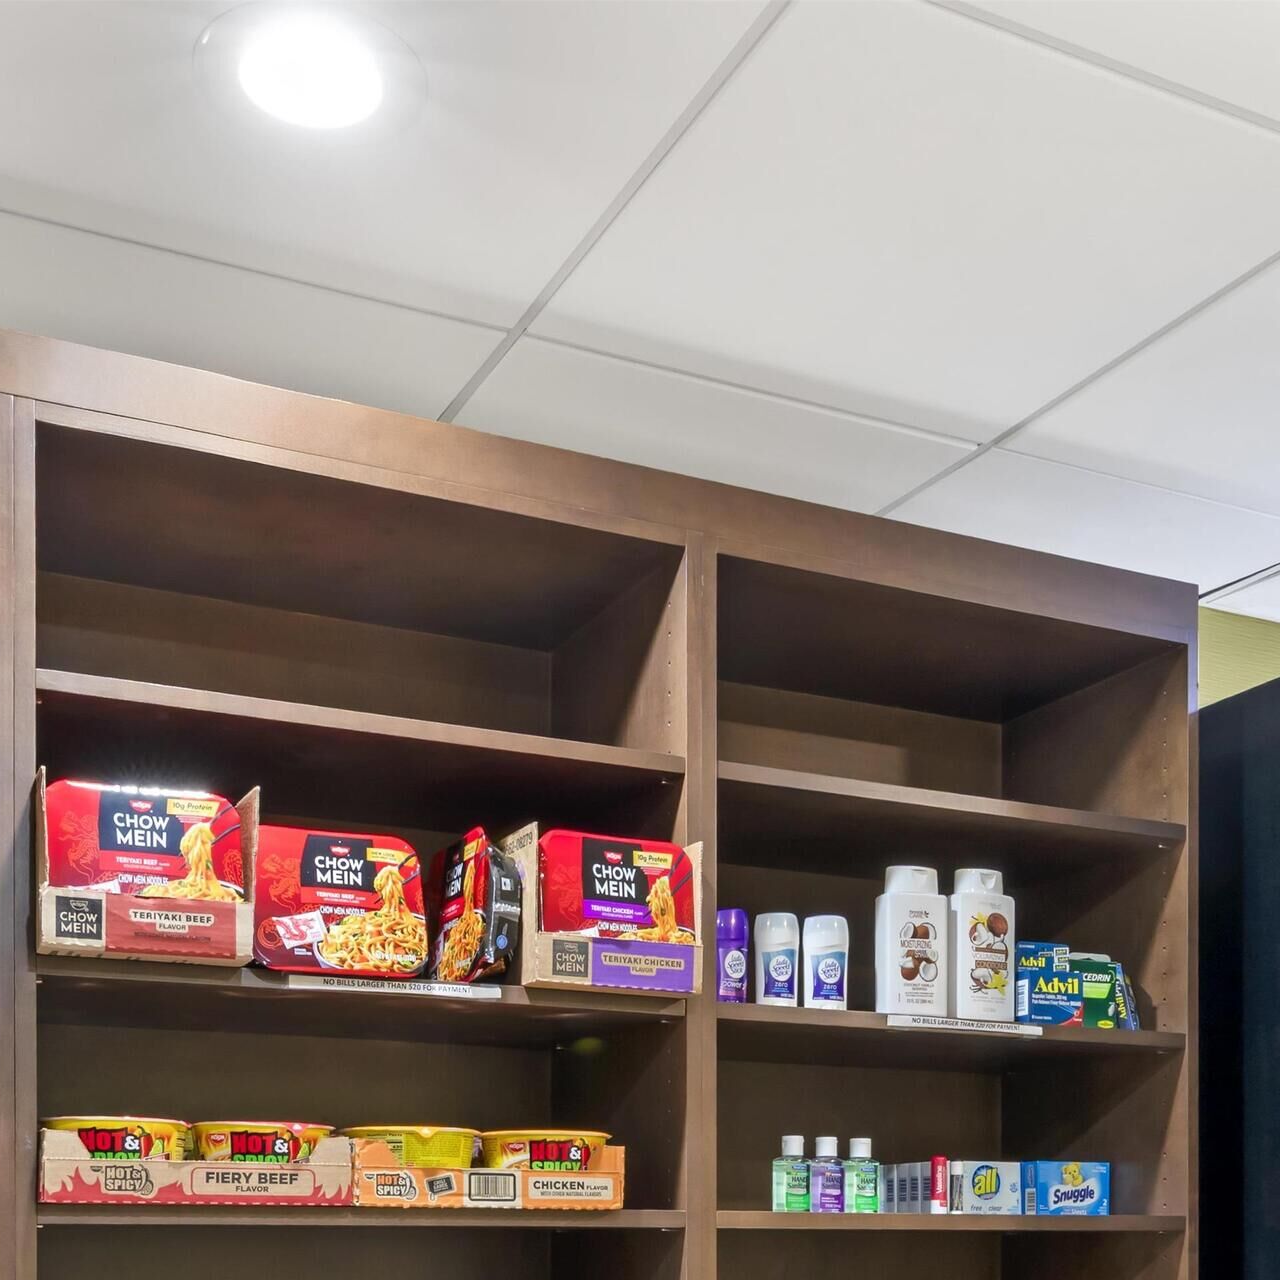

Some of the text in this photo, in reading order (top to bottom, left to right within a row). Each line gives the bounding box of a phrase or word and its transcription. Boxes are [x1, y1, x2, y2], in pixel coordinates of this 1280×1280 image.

[113, 812, 169, 830] CHOW
[116, 828, 167, 849] MEIN
[314, 856, 364, 871] CHOW
[316, 869, 362, 886] MEIN
[592, 863, 637, 882] CHOW
[594, 878, 636, 899] MEIN
[60, 911, 97, 922] CHOW
[132, 911, 212, 924] TERIYAKI BEEF
[60, 922, 97, 934] MEIN
[158, 923, 186, 931] FLAVOR
[556, 952, 585, 963] CHOW
[603, 954, 682, 968] TERIYAKI CHICKEN
[1019, 956, 1046, 968] Advil
[556, 962, 585, 973] MEIN
[1083, 973, 1112, 982] CEDRIN
[322, 978, 471, 993] NO BILLS LARGER THAN $20 FOR PAYMENT
[1034, 976, 1079, 994] Advil
[937, 1019, 958, 1027] LARGER
[106, 1179, 141, 1190] SPICY
[205, 1171, 299, 1185] FIERY BEEF
[935, 1165, 943, 1194] Vaseline
[974, 1167, 998, 1195] all
[235, 1185, 269, 1193] FLAVOR
[377, 1185, 406, 1196] SPICY
[533, 1180, 585, 1191] CHICKEN
[1053, 1185, 1095, 1205] Snuggle
